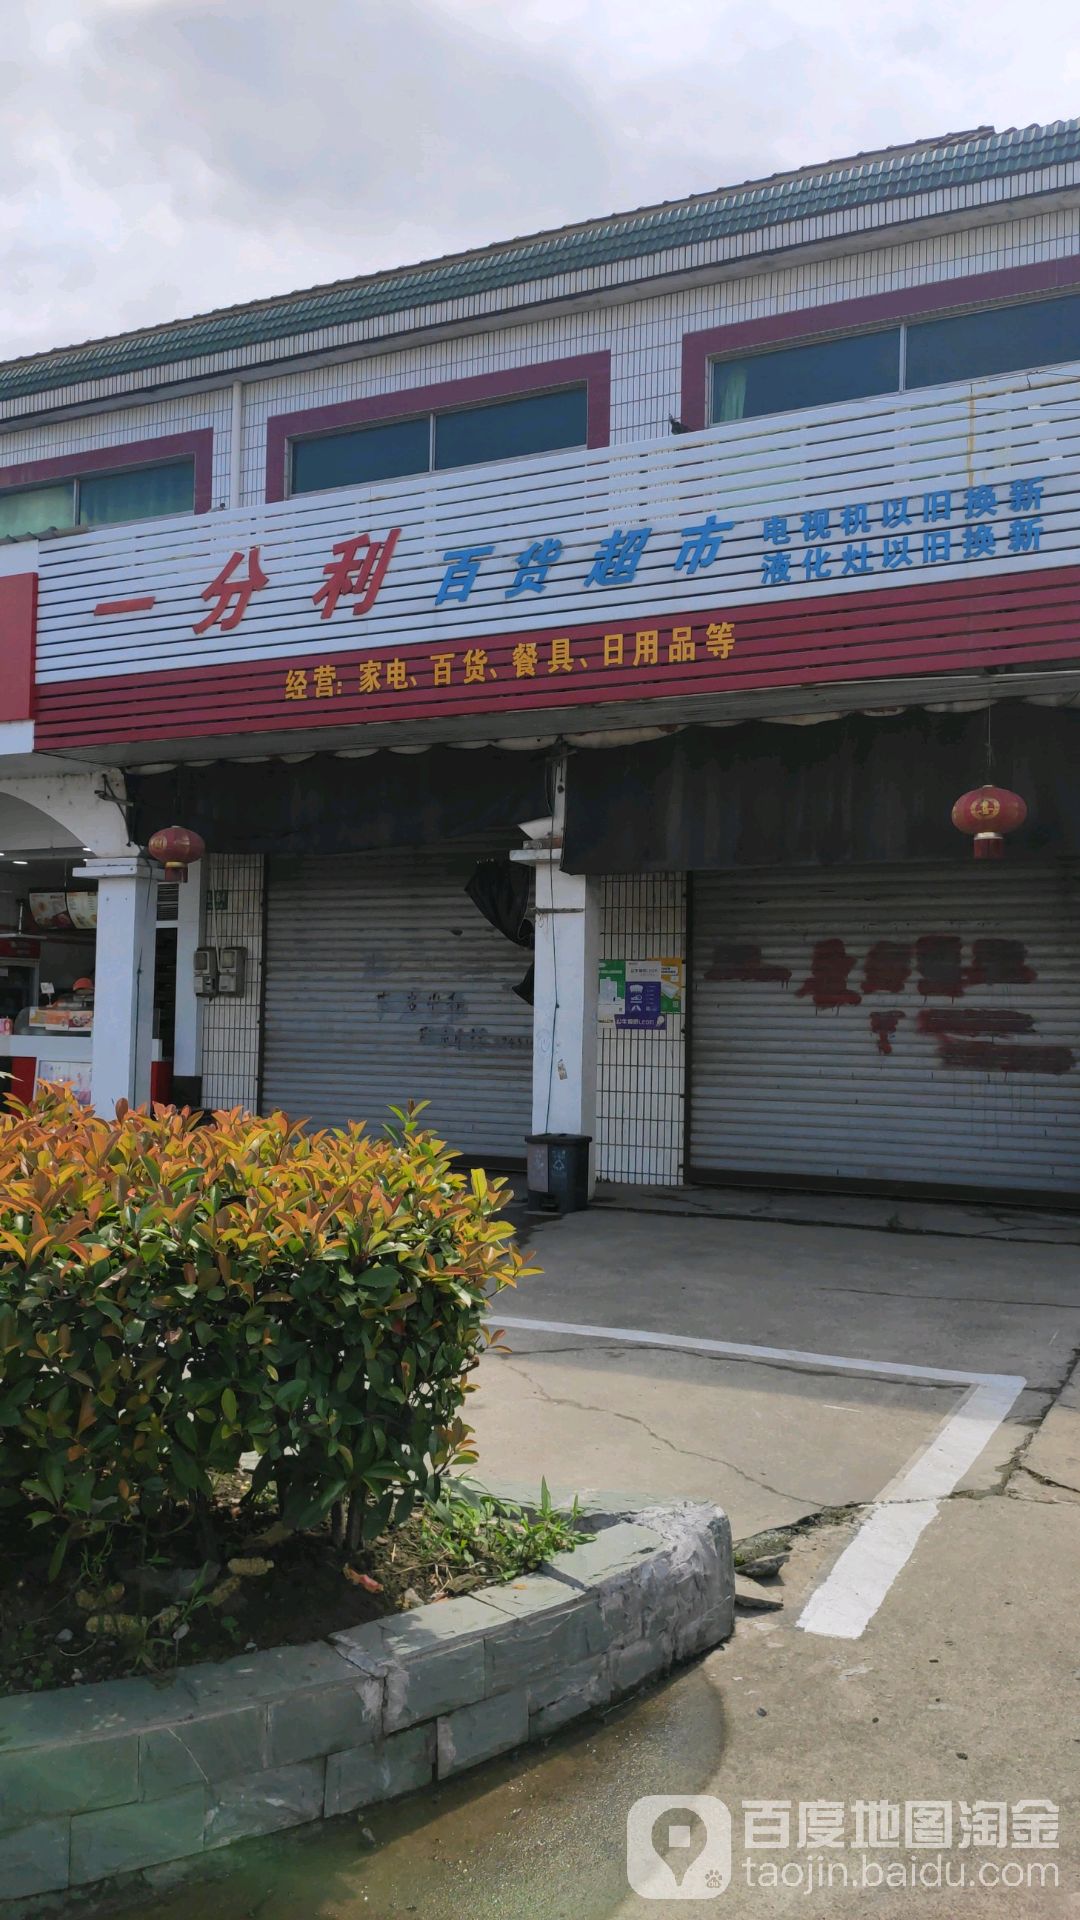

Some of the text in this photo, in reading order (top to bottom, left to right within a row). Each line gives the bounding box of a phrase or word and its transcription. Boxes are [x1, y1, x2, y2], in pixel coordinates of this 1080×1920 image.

[763, 476, 1044, 546] 电视机以旧换新
[94, 515, 735, 635] 一分利 百货超市
[761, 517, 1043, 584] 液化灶以旧换新
